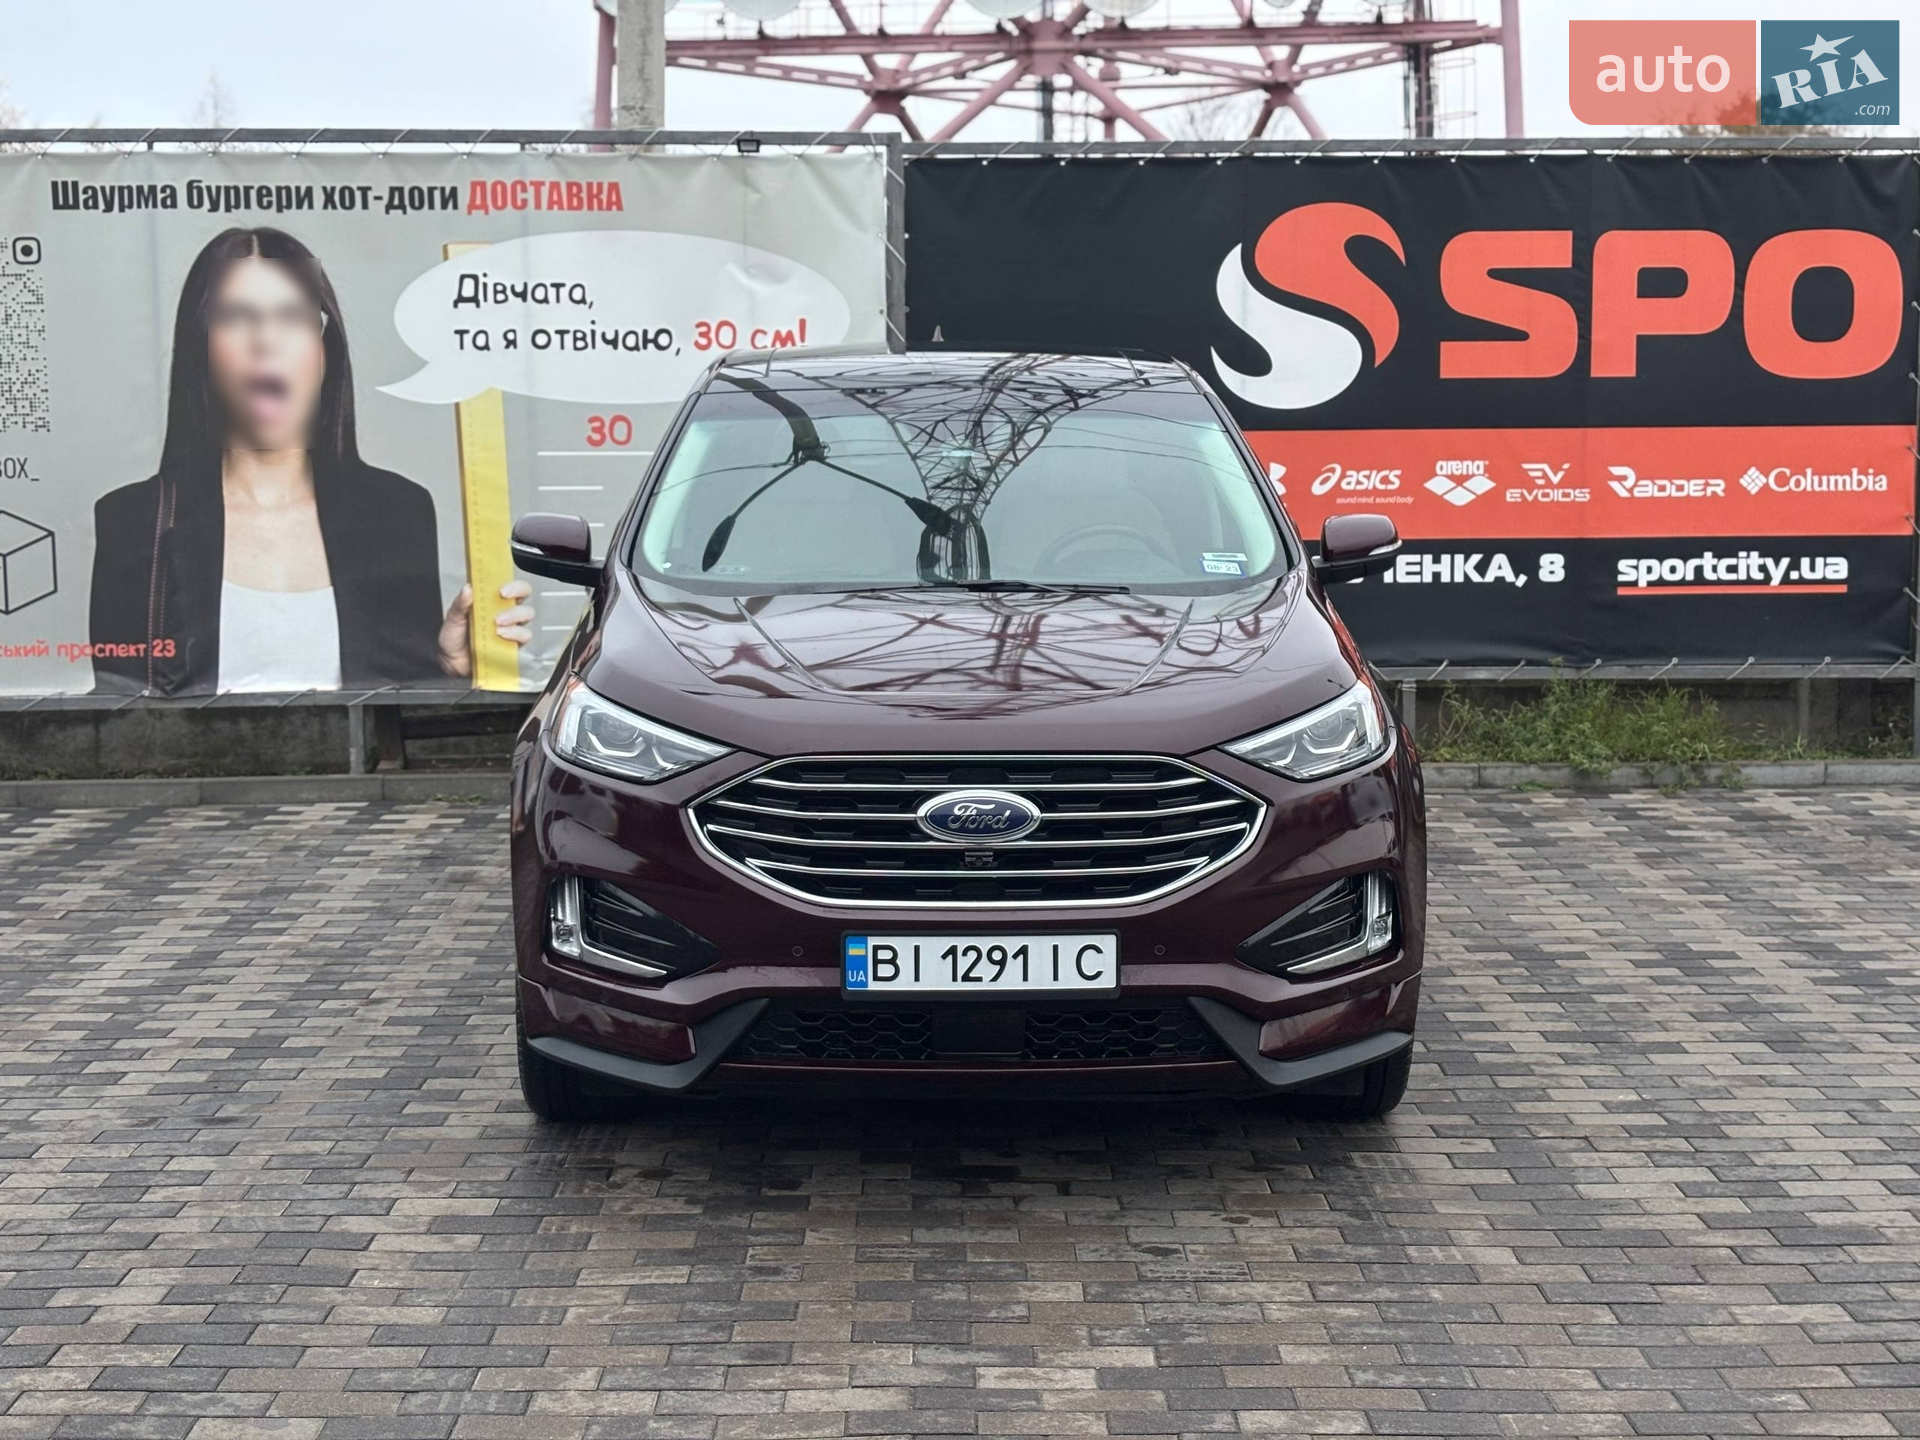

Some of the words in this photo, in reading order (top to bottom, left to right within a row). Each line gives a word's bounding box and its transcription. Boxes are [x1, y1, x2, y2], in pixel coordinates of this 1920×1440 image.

[51, 180, 177, 213] Шаурма
[186, 179, 314, 213] бургери
[321, 185, 459, 215] хот-доги
[466, 179, 624, 215] ДОСТАВКА
[453, 272, 594, 309] Дівчата,
[1440, 229, 1904, 379] SPO
[454, 329, 491, 351] та
[502, 329, 517, 349] я
[531, 320, 681, 356] отвічаю,
[694, 320, 737, 350] 30
[751, 318, 807, 350] см!
[586, 414, 633, 447] 30
[1436, 460, 1485, 475] arena
[1768, 467, 1888, 492] Columbia
[1396, 495, 1414, 505] body
[1505, 489, 1590, 502] EVOIDS
[1538, 553, 1566, 582] 8
[1617, 551, 1849, 587] sportcity.ua
[57, 642, 147, 663] проспект
[152, 639, 176, 657] 23
[947, 802, 1011, 830] Ford
[848, 970, 866, 982] UA
[940, 944, 1029, 982] 1291
